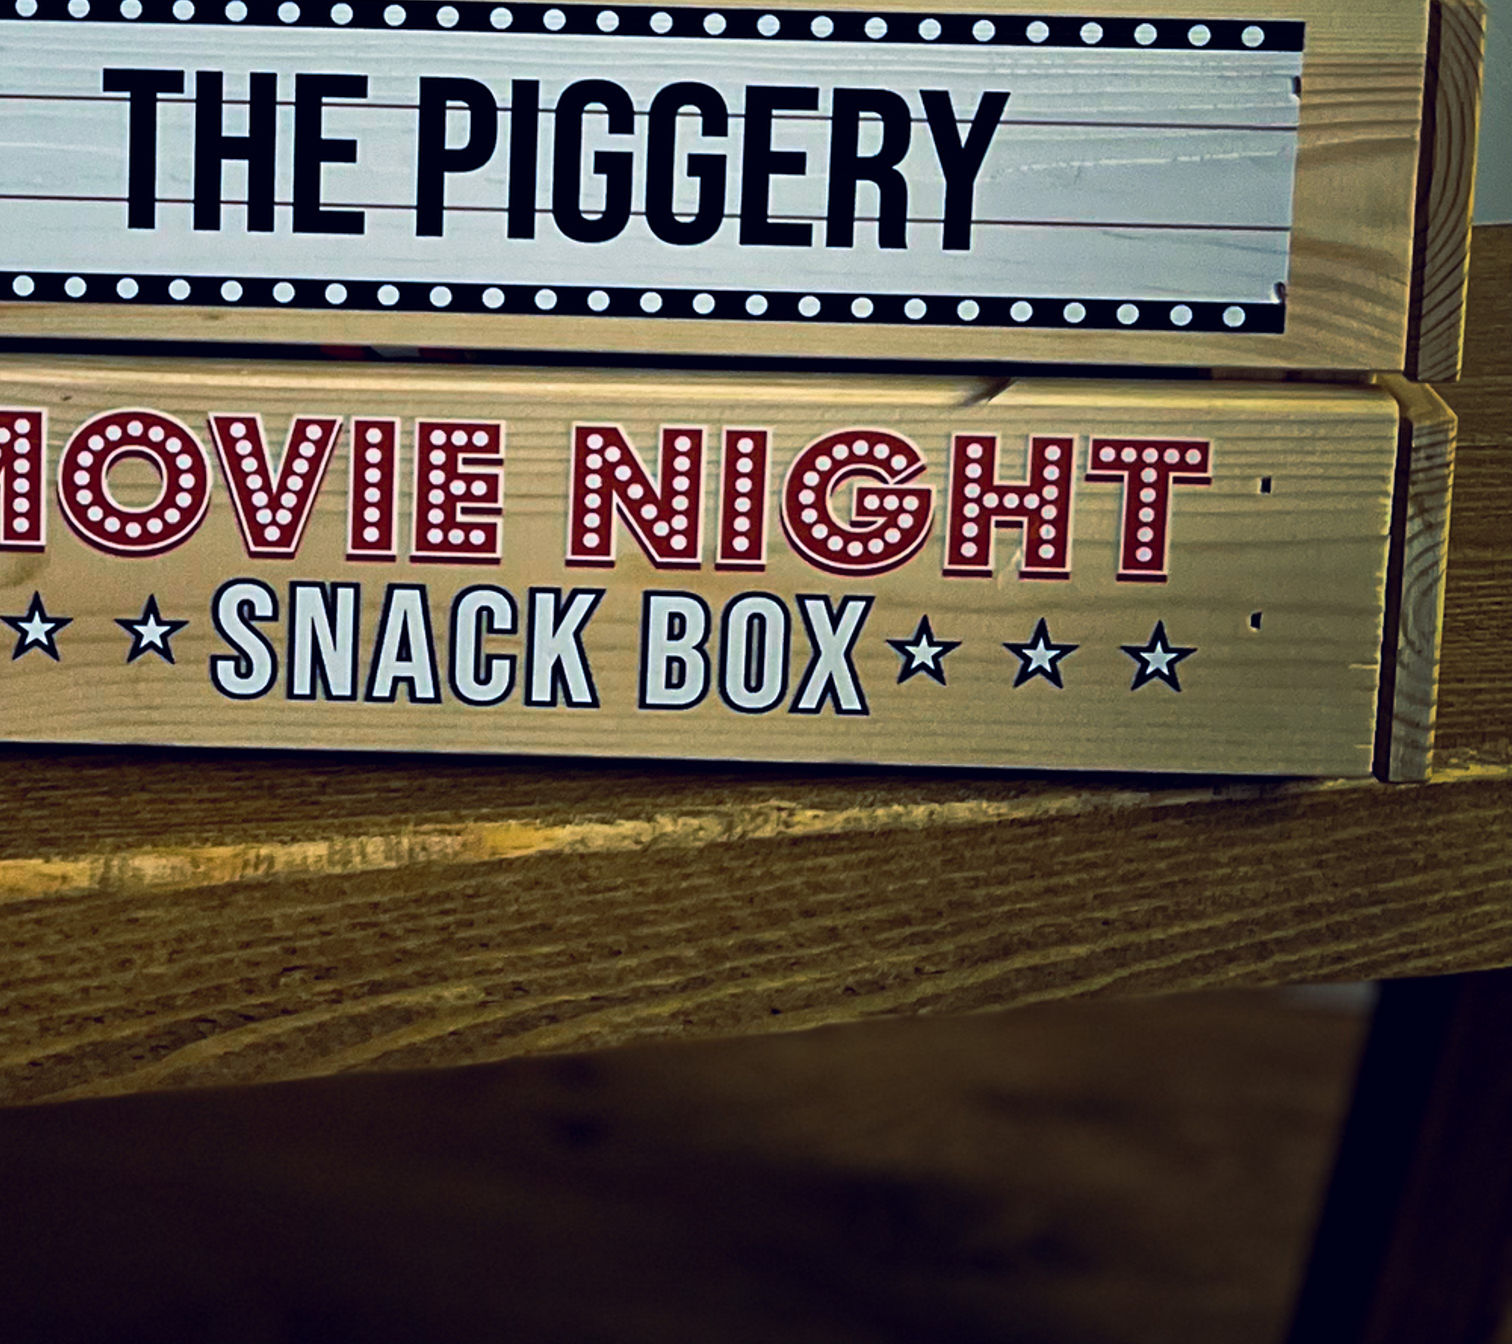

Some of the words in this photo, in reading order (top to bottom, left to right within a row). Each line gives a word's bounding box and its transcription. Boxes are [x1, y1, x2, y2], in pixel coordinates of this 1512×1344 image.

[102, 67, 369, 235] THE
[415, 76, 1011, 251] PIGGERY
[565, 421, 1213, 584] NIGHT
[210, 577, 607, 709] SNACK
[639, 589, 876, 717] BOX
